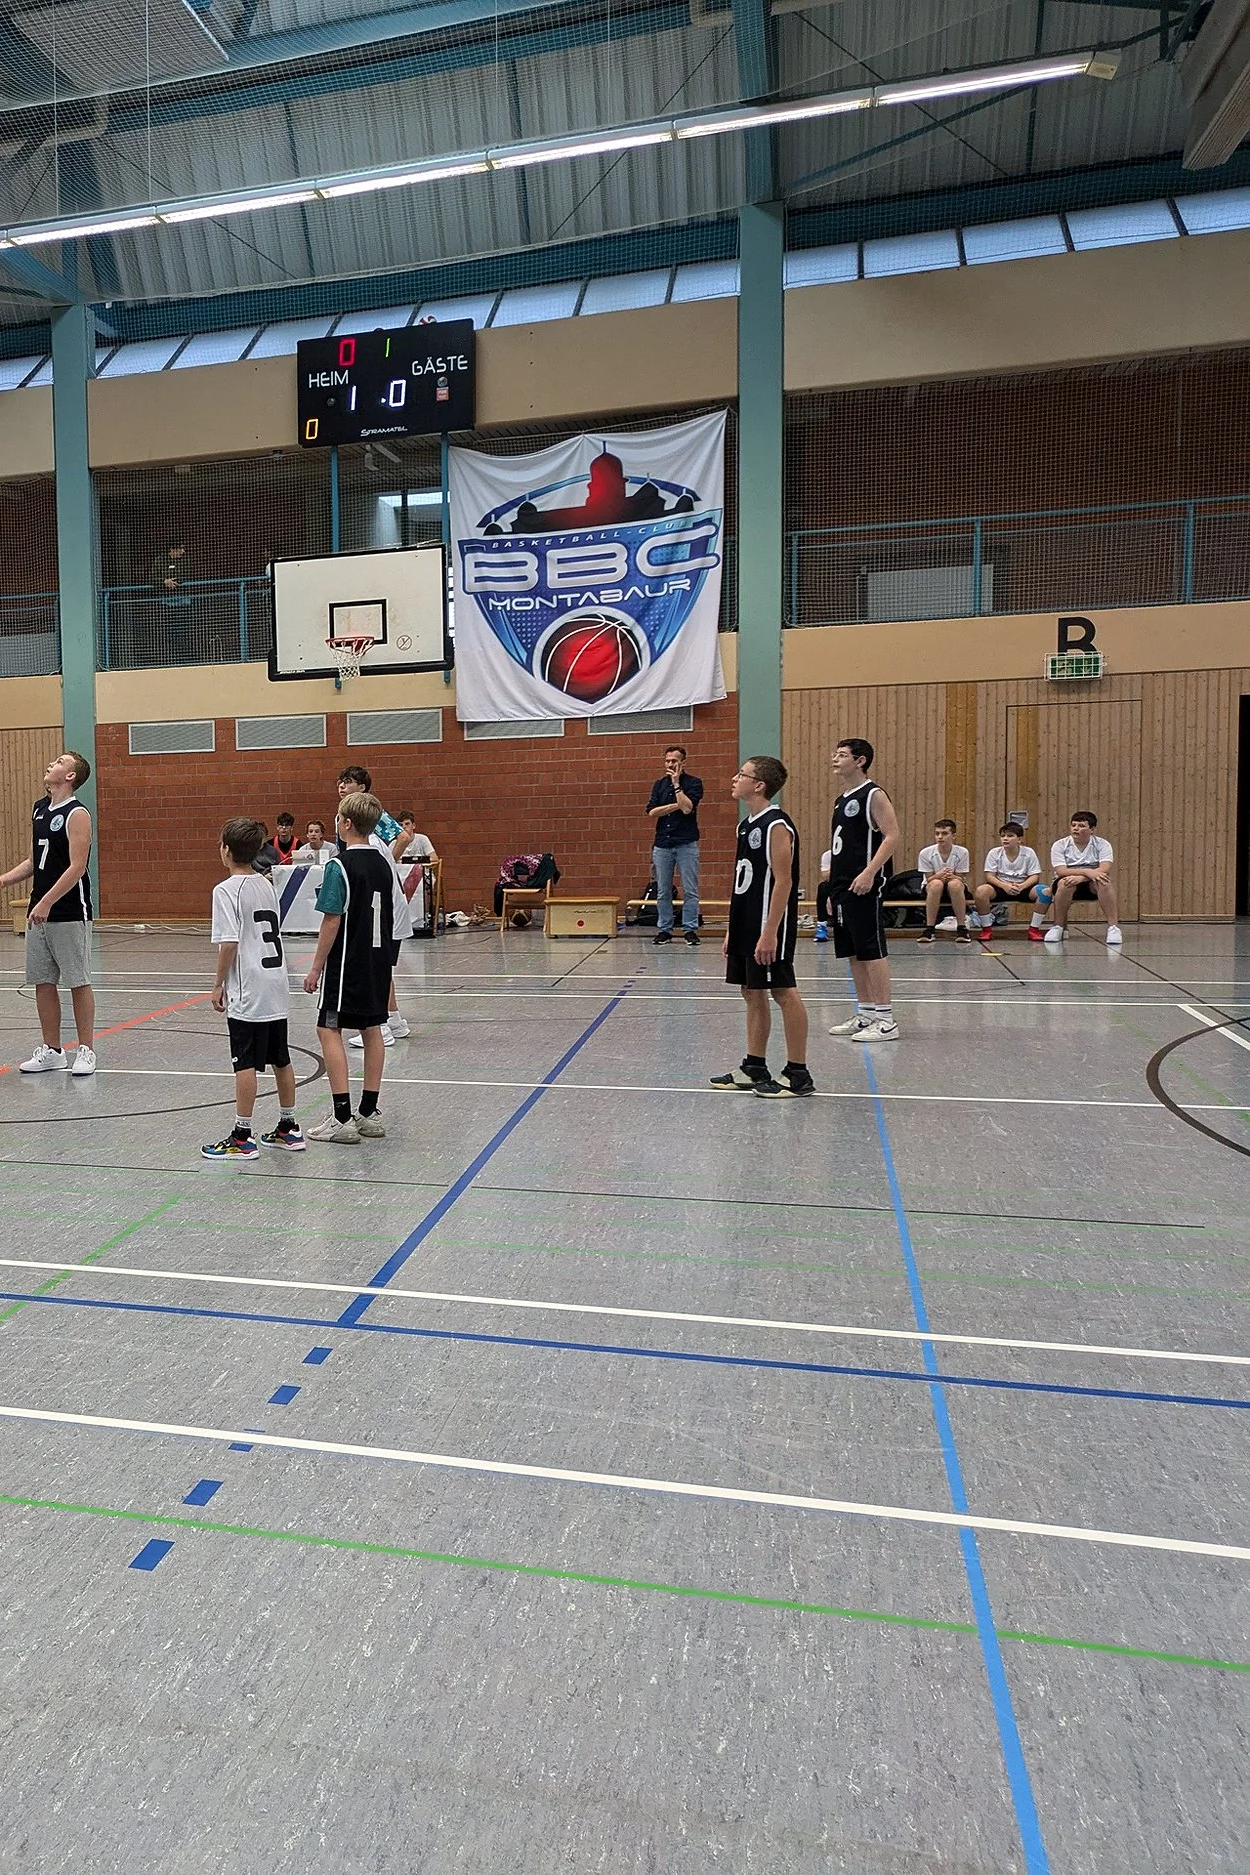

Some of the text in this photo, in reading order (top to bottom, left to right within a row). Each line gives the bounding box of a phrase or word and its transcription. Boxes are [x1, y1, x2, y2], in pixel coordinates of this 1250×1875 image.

[339, 338, 356, 367] 0
[411, 354, 469, 376] GÄSTE
[308, 369, 350, 389] HEIM
[305, 418, 319, 440] 0
[359, 425, 409, 437] STRAMATEL
[463, 522, 721, 593] BBC
[488, 578, 691, 611] MONTABAUR
[38, 838, 49, 871] 7
[832, 824, 843, 856] 6
[371, 890, 382, 948] 1
[253, 909, 284, 969] 3
